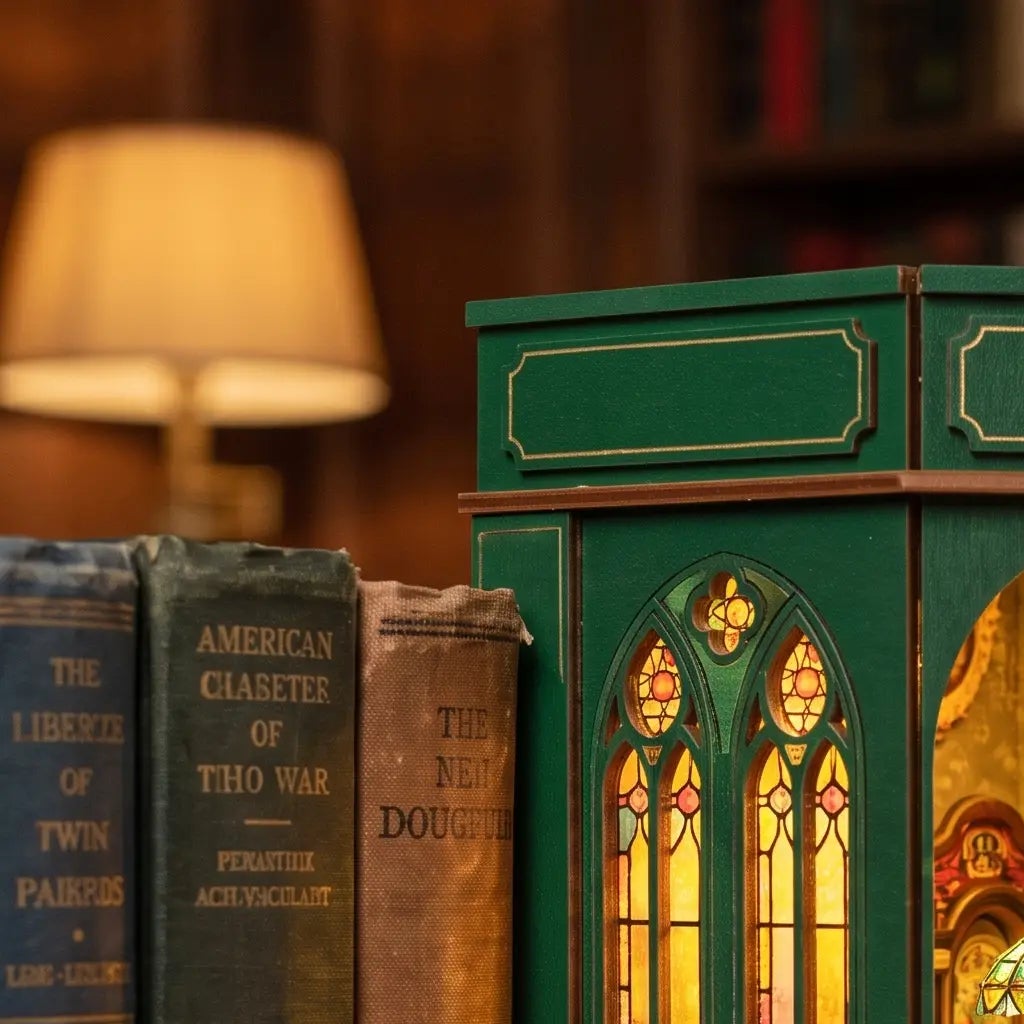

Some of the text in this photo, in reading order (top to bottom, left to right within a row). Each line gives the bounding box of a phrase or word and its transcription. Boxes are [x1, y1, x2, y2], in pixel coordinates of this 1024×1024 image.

[197, 625, 334, 660] AMERICAN
[50, 657, 102, 688] THE
[251, 719, 284, 747] OF
[437, 706, 488, 739] THE
[59, 766, 94, 797] OF
[274, 766, 331, 796] WAR
[36, 820, 109, 851] TWIN
